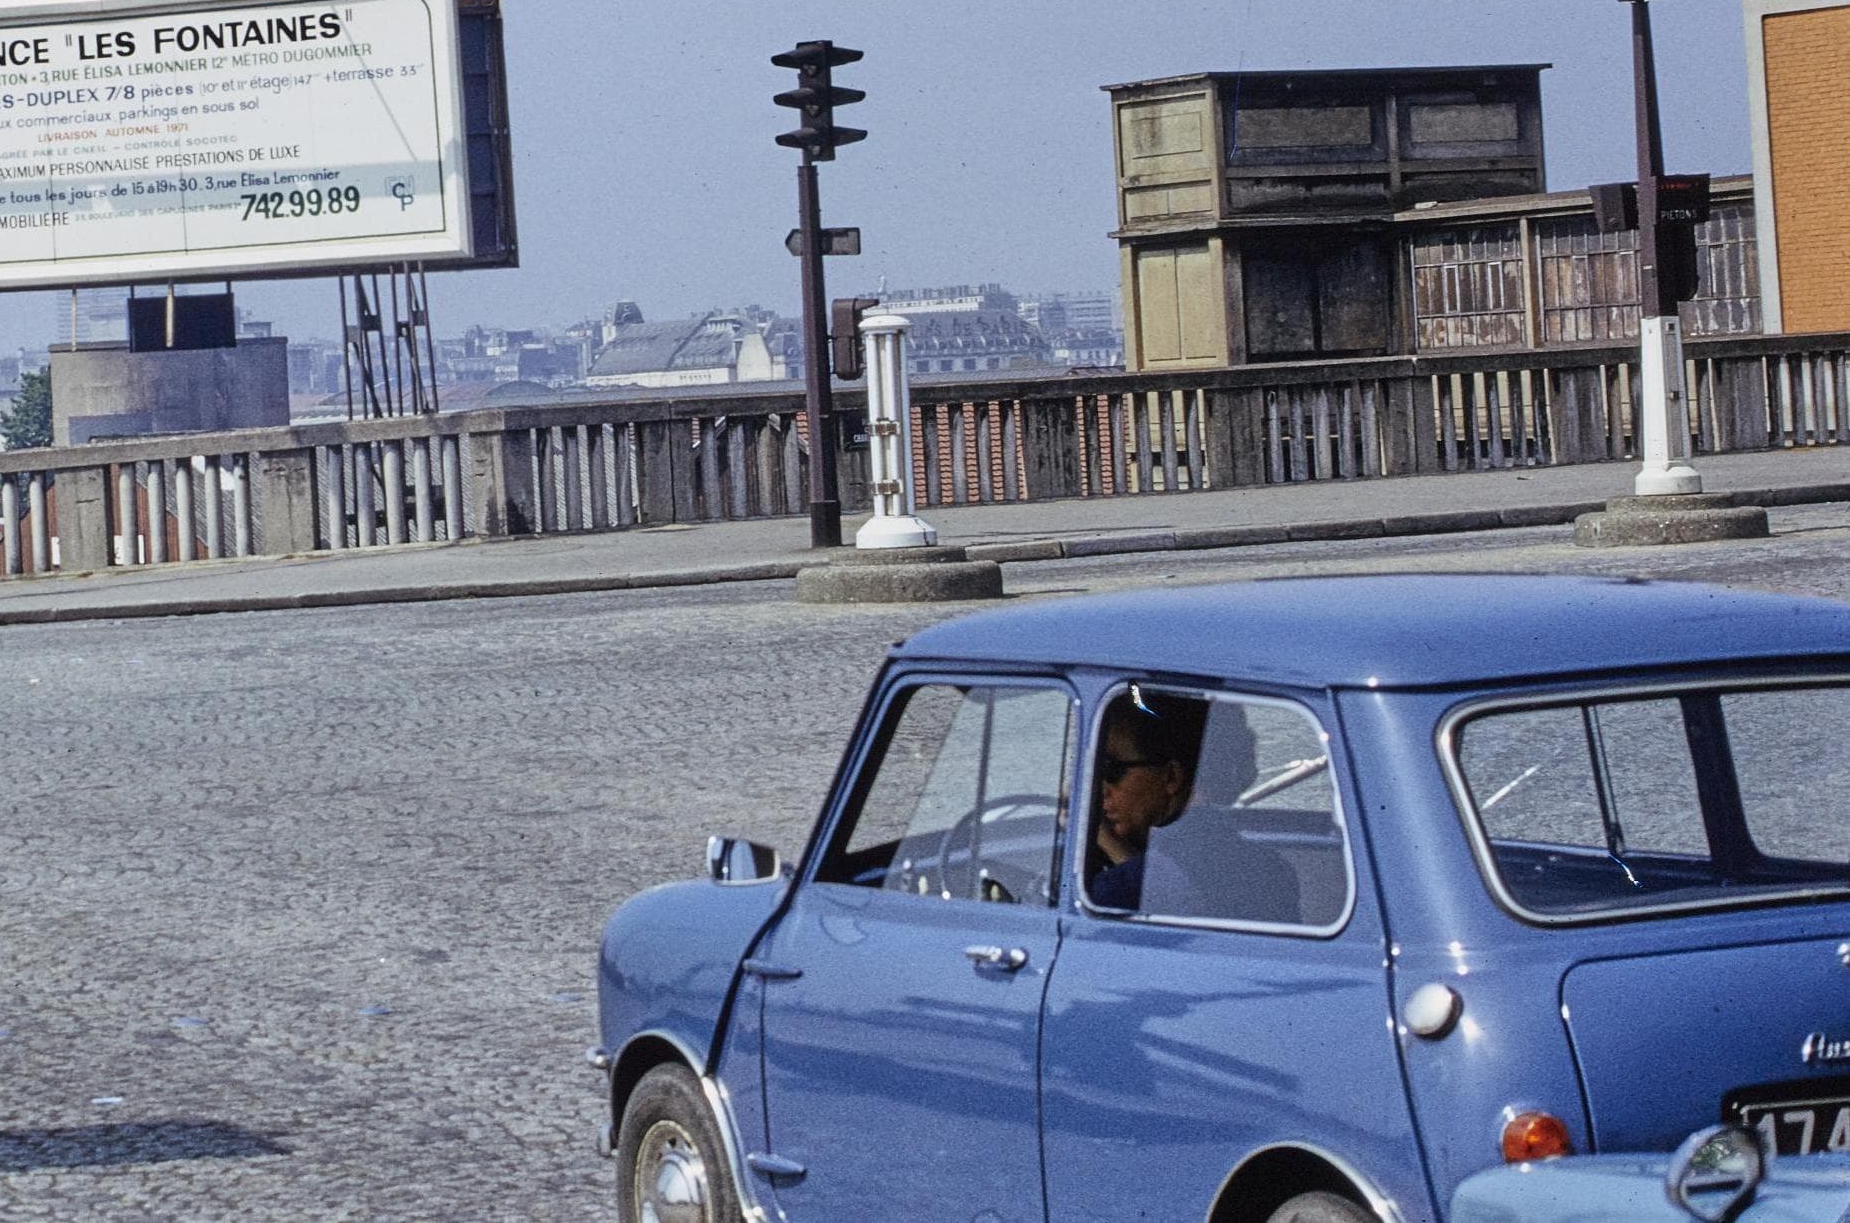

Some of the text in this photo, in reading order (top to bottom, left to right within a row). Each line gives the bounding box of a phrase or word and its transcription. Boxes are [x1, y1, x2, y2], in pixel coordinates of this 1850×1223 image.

[154, 8, 353, 54] FONTAINES"
[128, 58, 207, 76] LEMONNIER
[283, 43, 372, 63] DUGOMMIER
[105, 85, 135, 102] 7/8
[141, 82, 194, 102] pièces
[221, 79, 234, 92] et
[16, 110, 111, 128] commerciaux
[119, 105, 178, 124] parkings
[182, 104, 199, 116] en
[202, 101, 235, 114] sous
[240, 97, 260, 111] sol
[38, 131, 97, 143] LIVRAISON
[105, 125, 160, 138] AUTOMNE
[186, 135, 238, 146] SOCOTEC
[249, 148, 264, 161] DE
[269, 144, 301, 159] LUXE
[11, 191, 42, 203] tous
[46, 188, 66, 201] les
[68, 187, 107, 206] jours
[111, 183, 127, 197] de
[132, 182, 144, 194] 15
[274, 170, 340, 184] Lemonnier
[241, 185, 360, 221] 742.99.89
